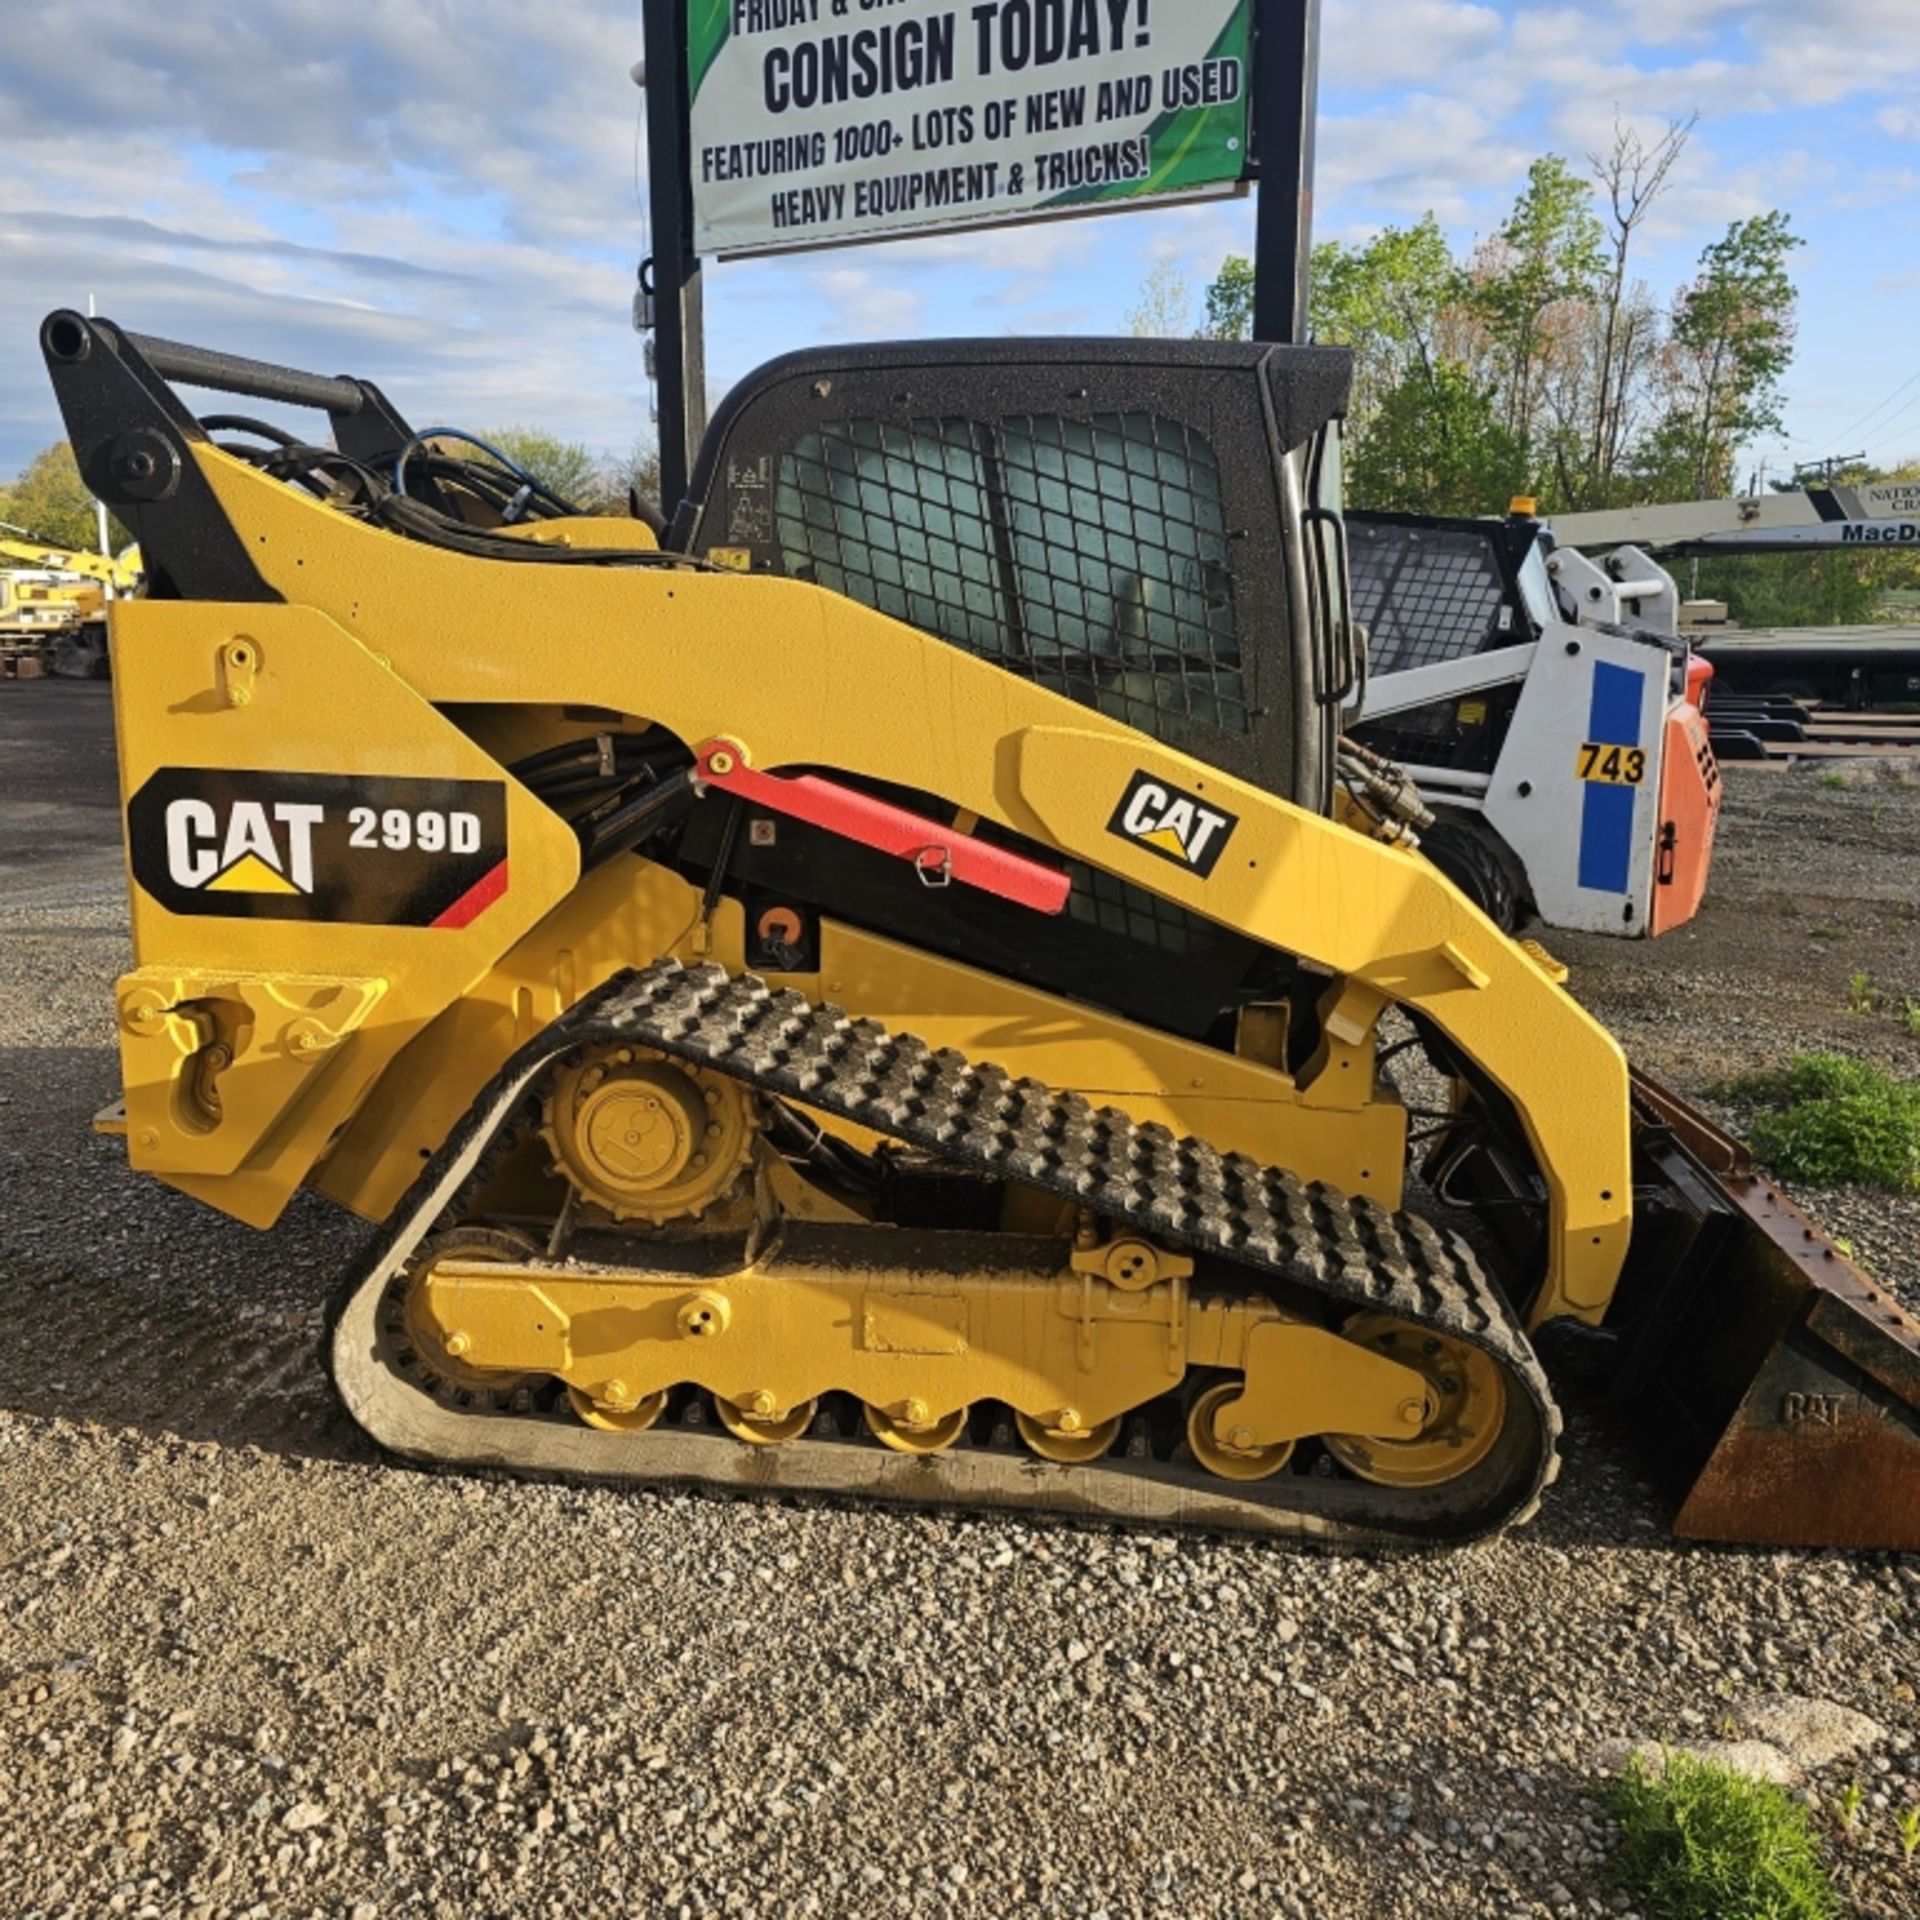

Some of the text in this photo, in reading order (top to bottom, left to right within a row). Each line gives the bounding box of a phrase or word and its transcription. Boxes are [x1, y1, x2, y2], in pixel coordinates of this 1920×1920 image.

[764, 0, 1149, 113] CONSIGN TODAY!
[702, 59, 1240, 183] FEATURING 1000+ LOTS OF NEW AND USED
[771, 138, 1149, 228] HEAVY EQUIPMENT & TRUCKS!
[1841, 524, 1920, 541] MacD
[1580, 743, 1645, 783] 743
[166, 799, 481, 894] CAT 299D
[1122, 783, 1227, 864] CAT
